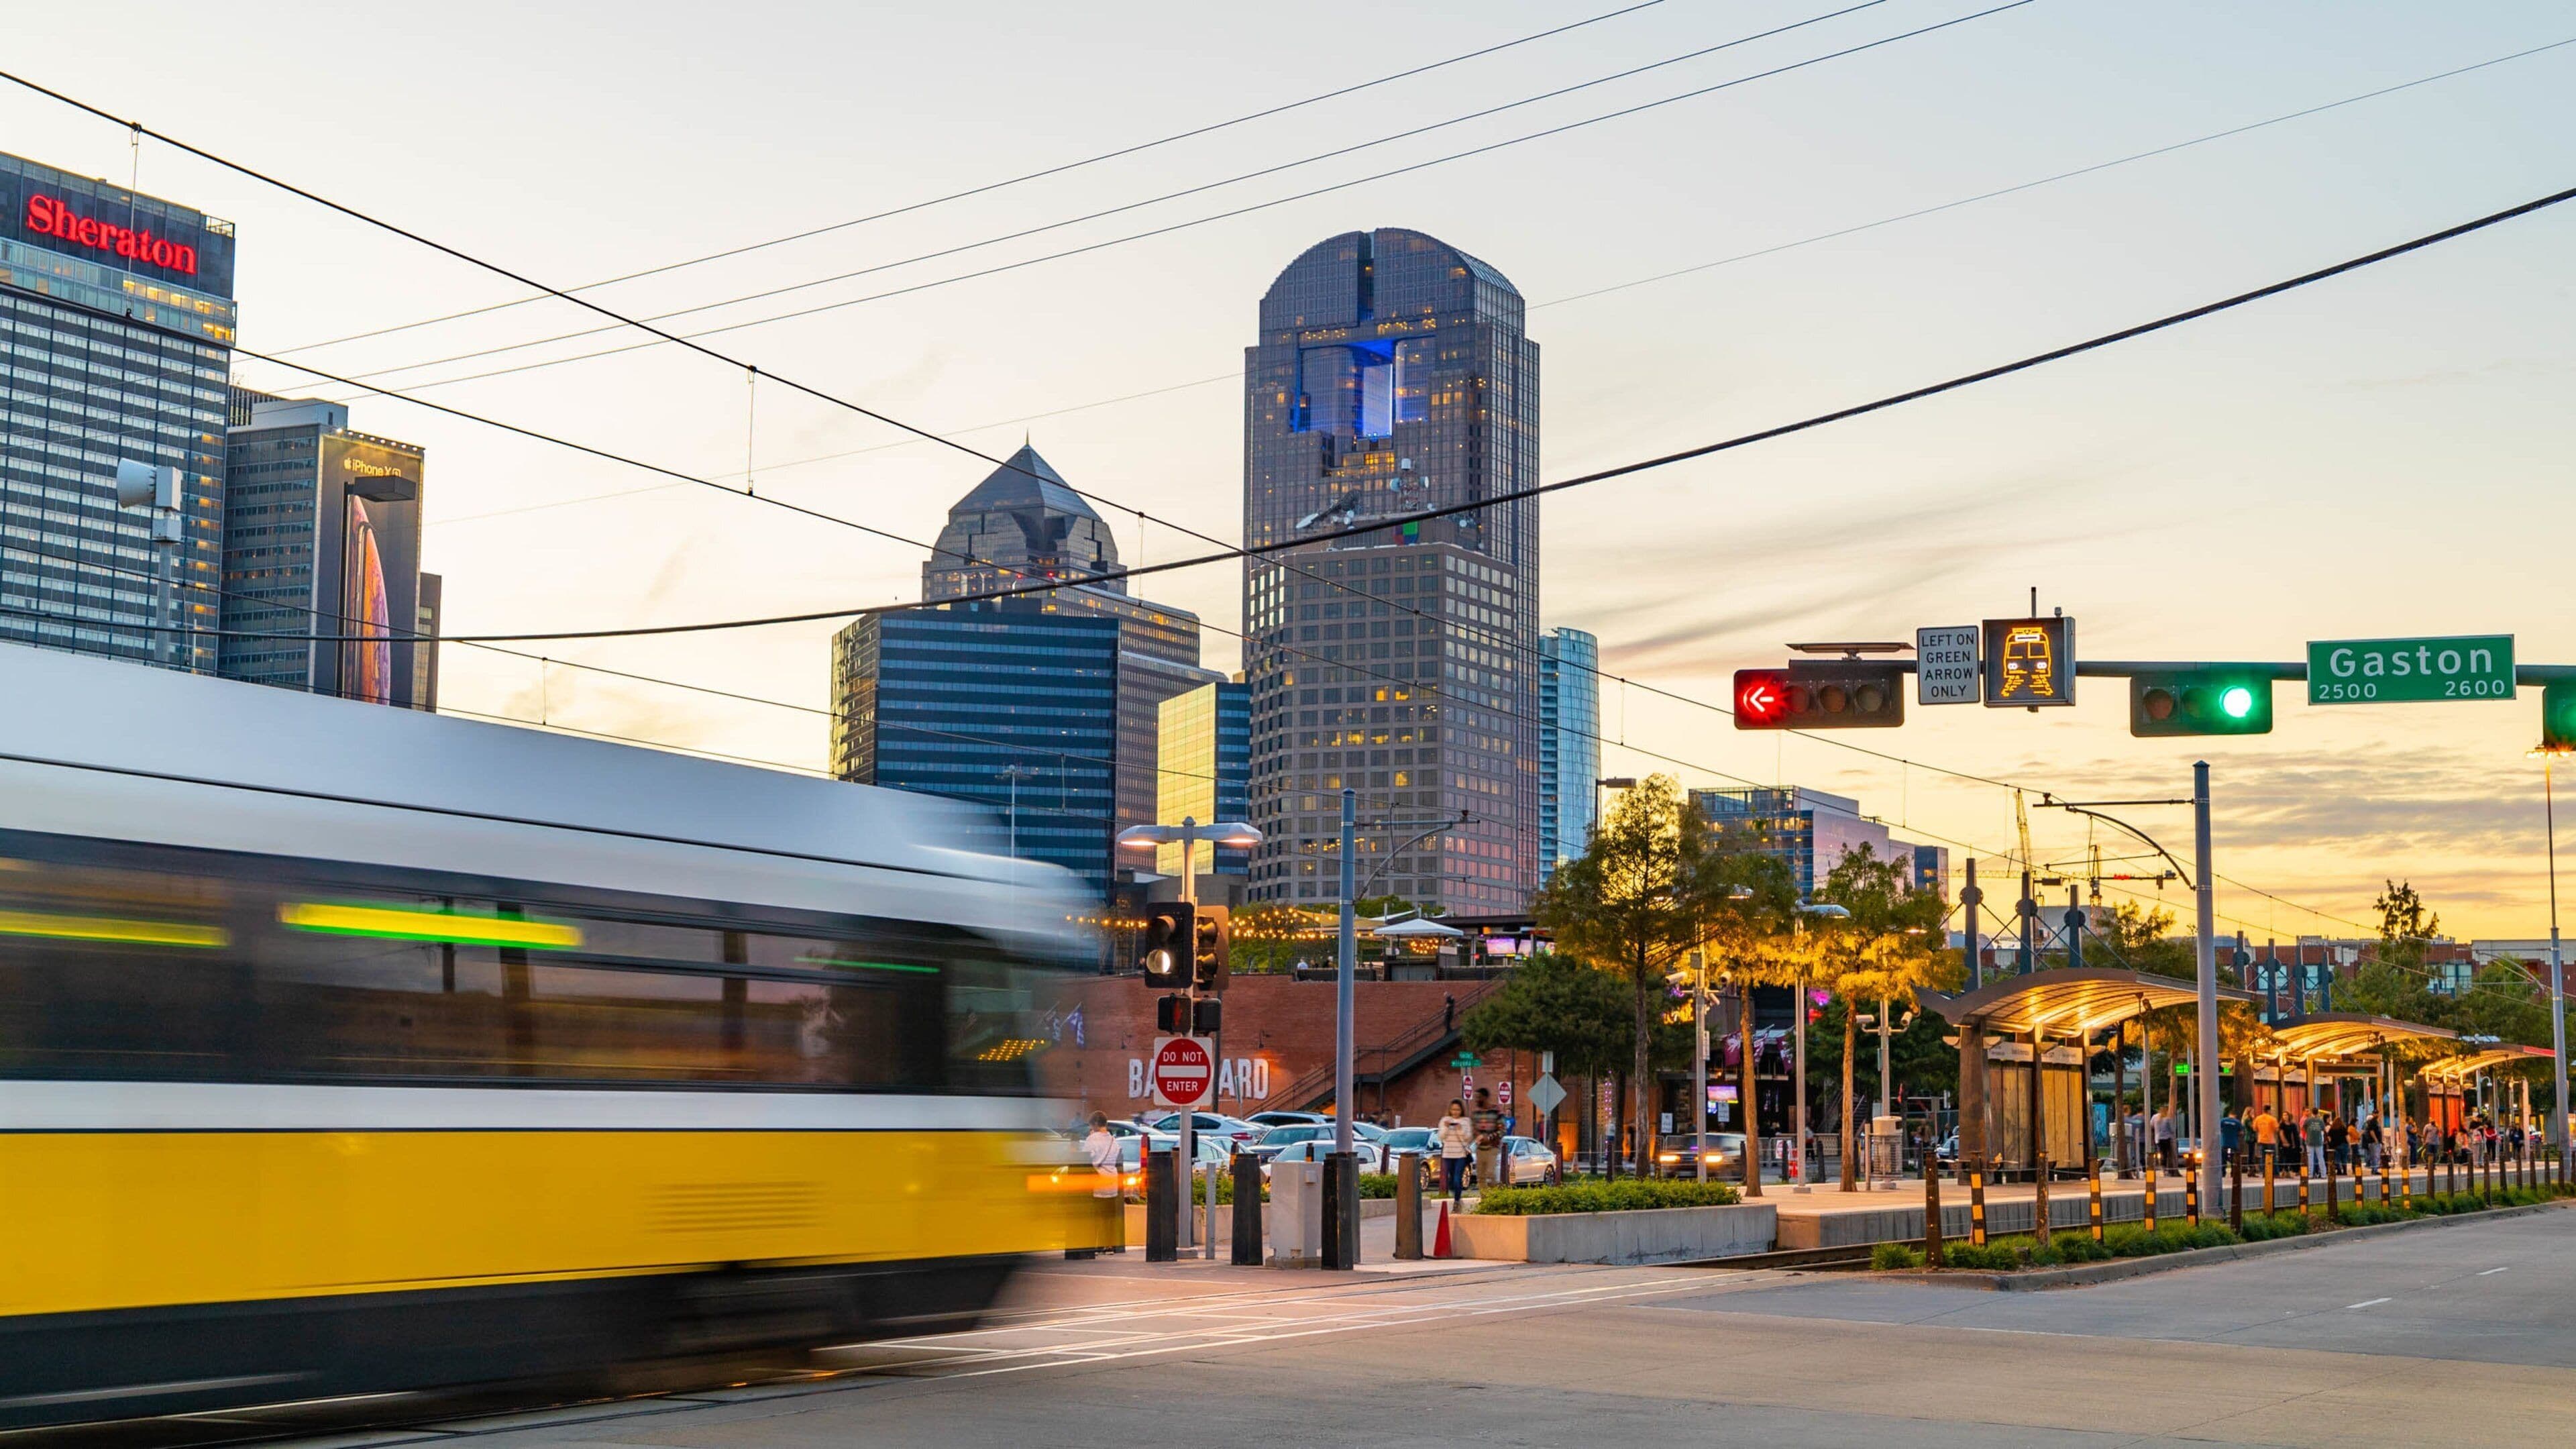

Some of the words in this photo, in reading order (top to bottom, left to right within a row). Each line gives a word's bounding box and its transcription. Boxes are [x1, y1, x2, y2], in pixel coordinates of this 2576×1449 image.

[27, 193, 197, 275] Sheraton
[352, 459, 383, 476] iPhone
[1921, 635, 1952, 647] LEFT
[1956, 634, 1974, 645] ON
[1926, 651, 1970, 663] GREEN
[2329, 645, 2492, 678] Gaston
[1925, 667, 1973, 680] ARROW
[1931, 685, 1967, 698] ONLY
[2318, 683, 2377, 699] 2500
[2445, 680, 2505, 696] 2600
[1163, 1052, 1177, 1063] DO
[1182, 1051, 1203, 1063] NOT
[1166, 1081, 1198, 1092] ENTER
